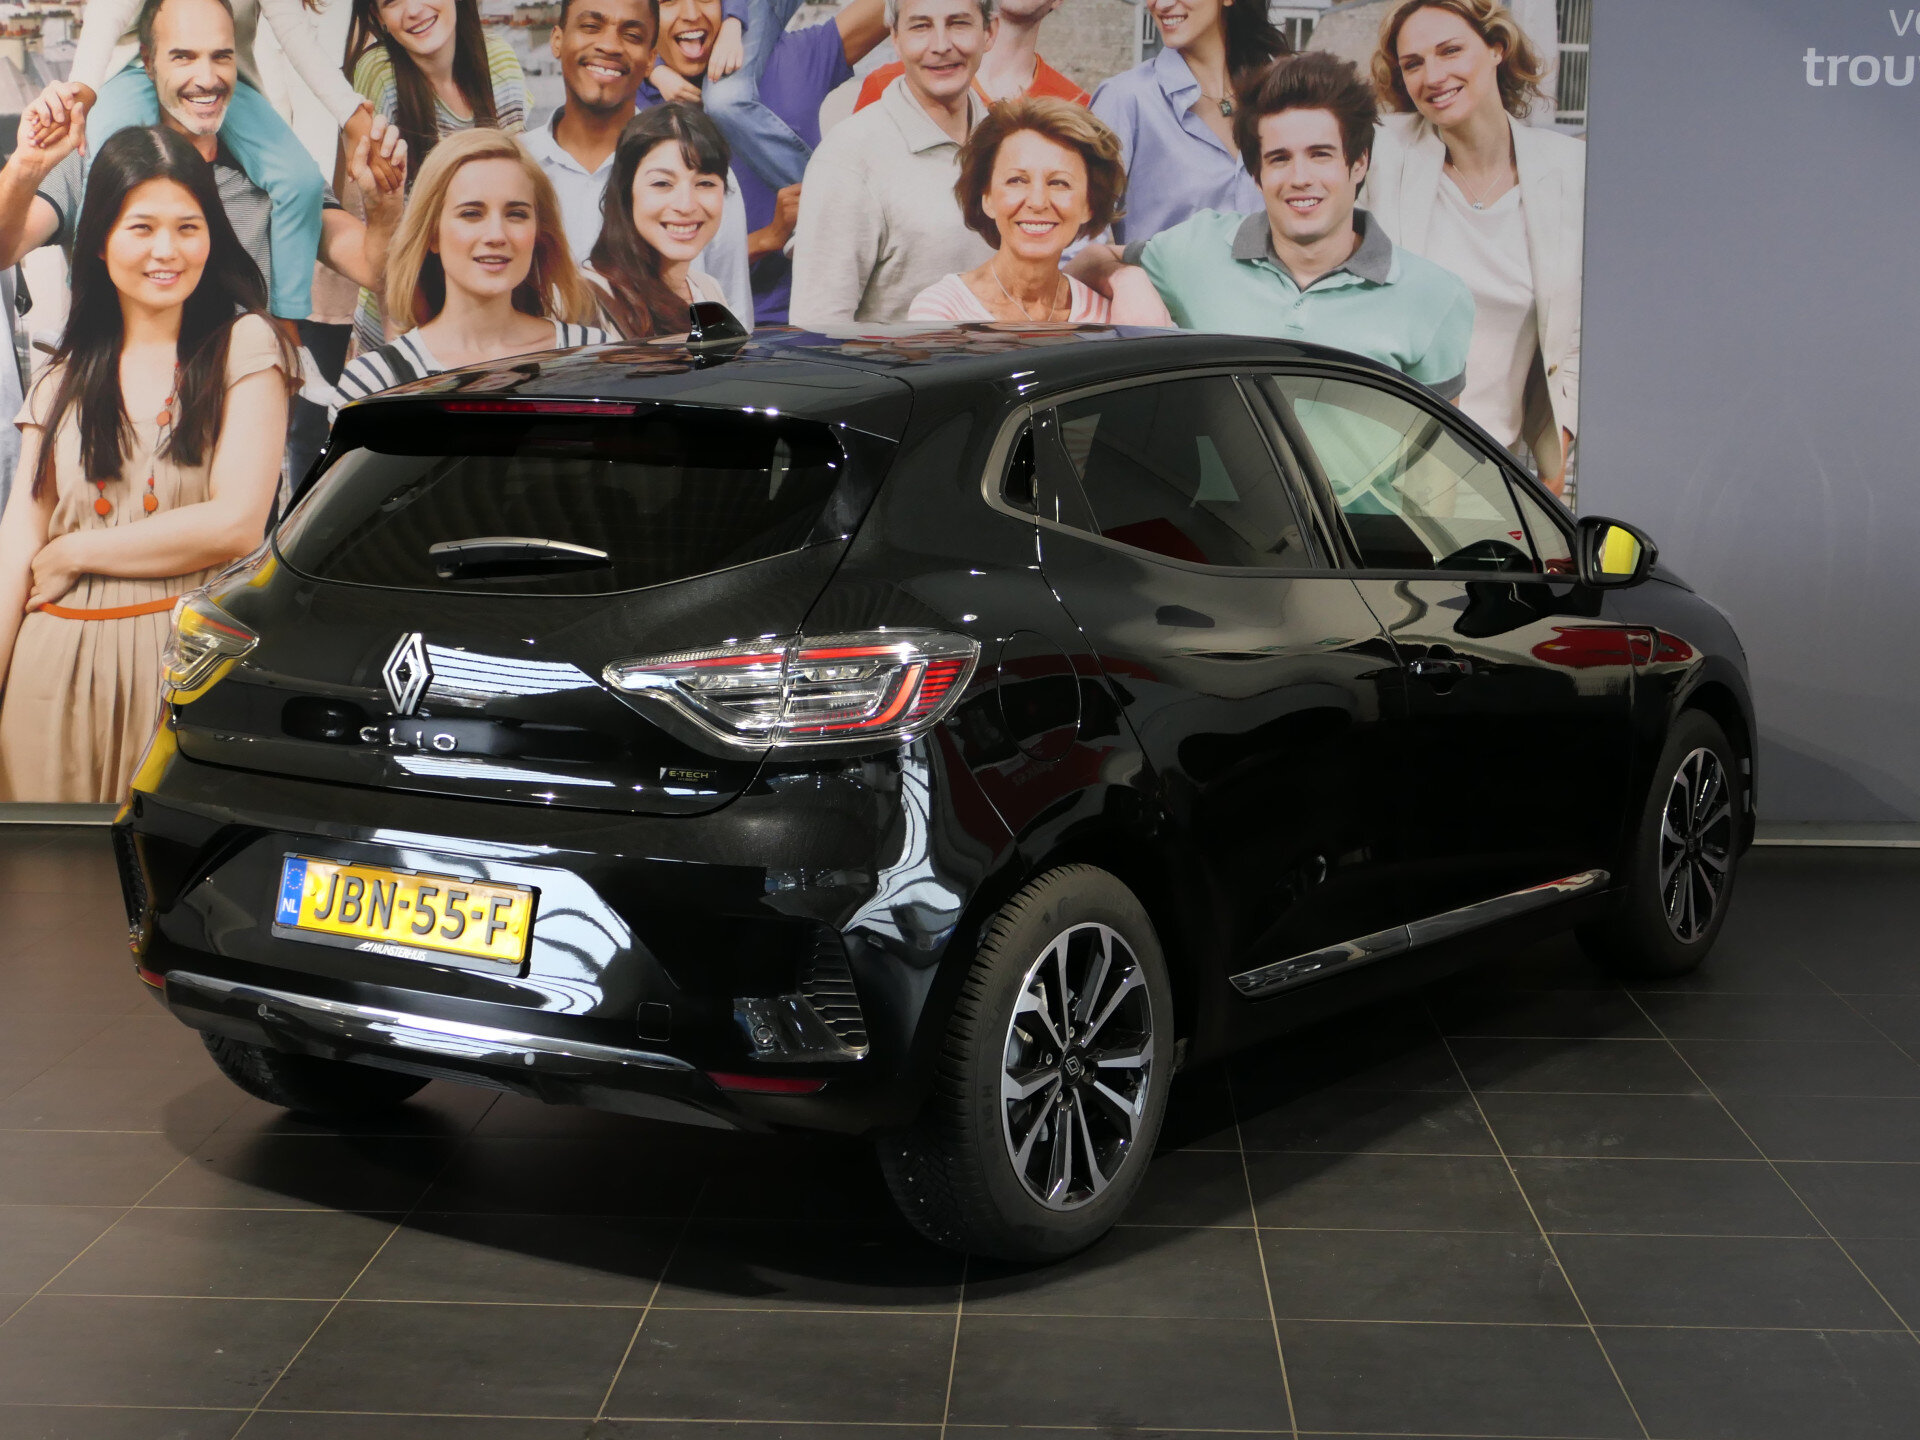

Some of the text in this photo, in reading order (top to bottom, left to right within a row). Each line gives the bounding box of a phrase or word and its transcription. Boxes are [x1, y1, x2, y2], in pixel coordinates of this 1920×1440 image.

[1802, 47, 1920, 87] trou
[360, 726, 457, 751] CLIO
[668, 770, 709, 779] E-TECH
[282, 897, 298, 914] NL
[314, 874, 513, 945] JBN-55-F
[371, 943, 428, 962] MUNSTERHUIS
